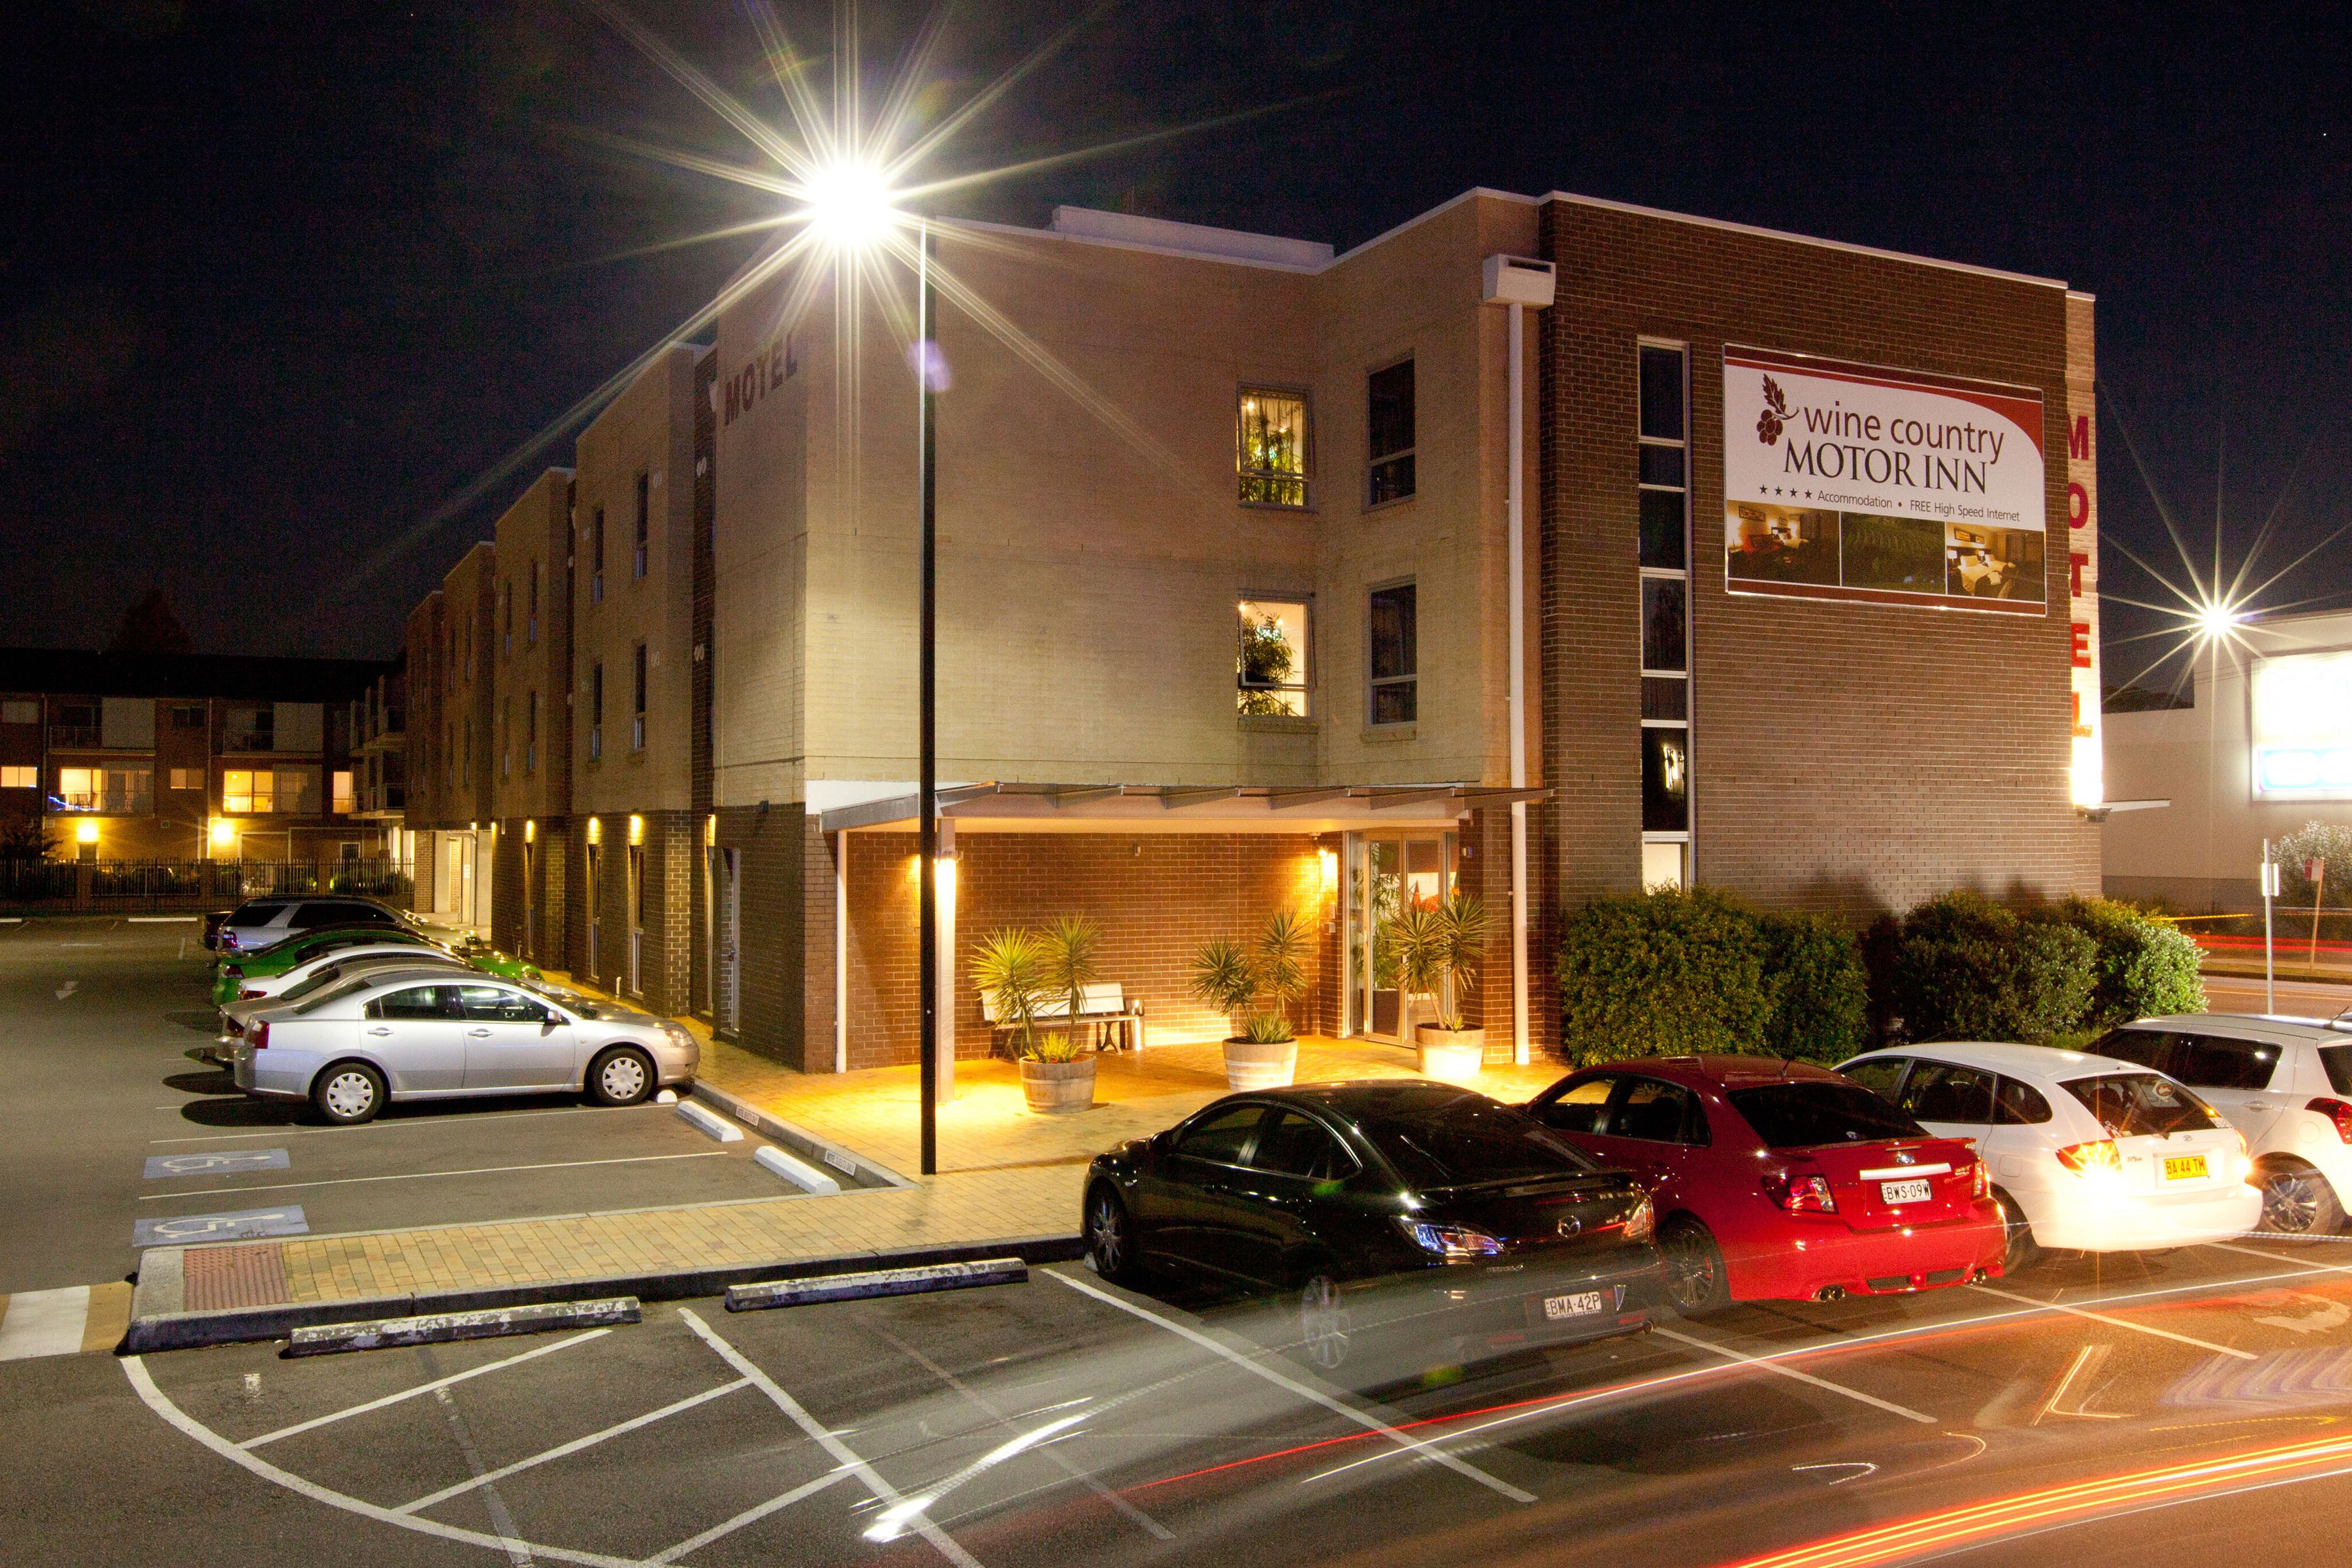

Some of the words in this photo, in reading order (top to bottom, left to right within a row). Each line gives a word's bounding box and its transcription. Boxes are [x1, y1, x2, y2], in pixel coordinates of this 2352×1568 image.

[725, 333, 798, 427] MOTEL
[1804, 400, 1881, 441] wine
[1890, 418, 2004, 465] country
[1783, 438, 1918, 487] MOTOR
[1922, 454, 1987, 495] INN
[1818, 490, 1892, 508] Accommodation
[1910, 500, 1931, 512] FREE
[1935, 502, 1955, 517] High
[1958, 504, 1984, 519] Speed
[1987, 508, 2020, 522] Internet
[2067, 414, 2092, 738] MOTEL
